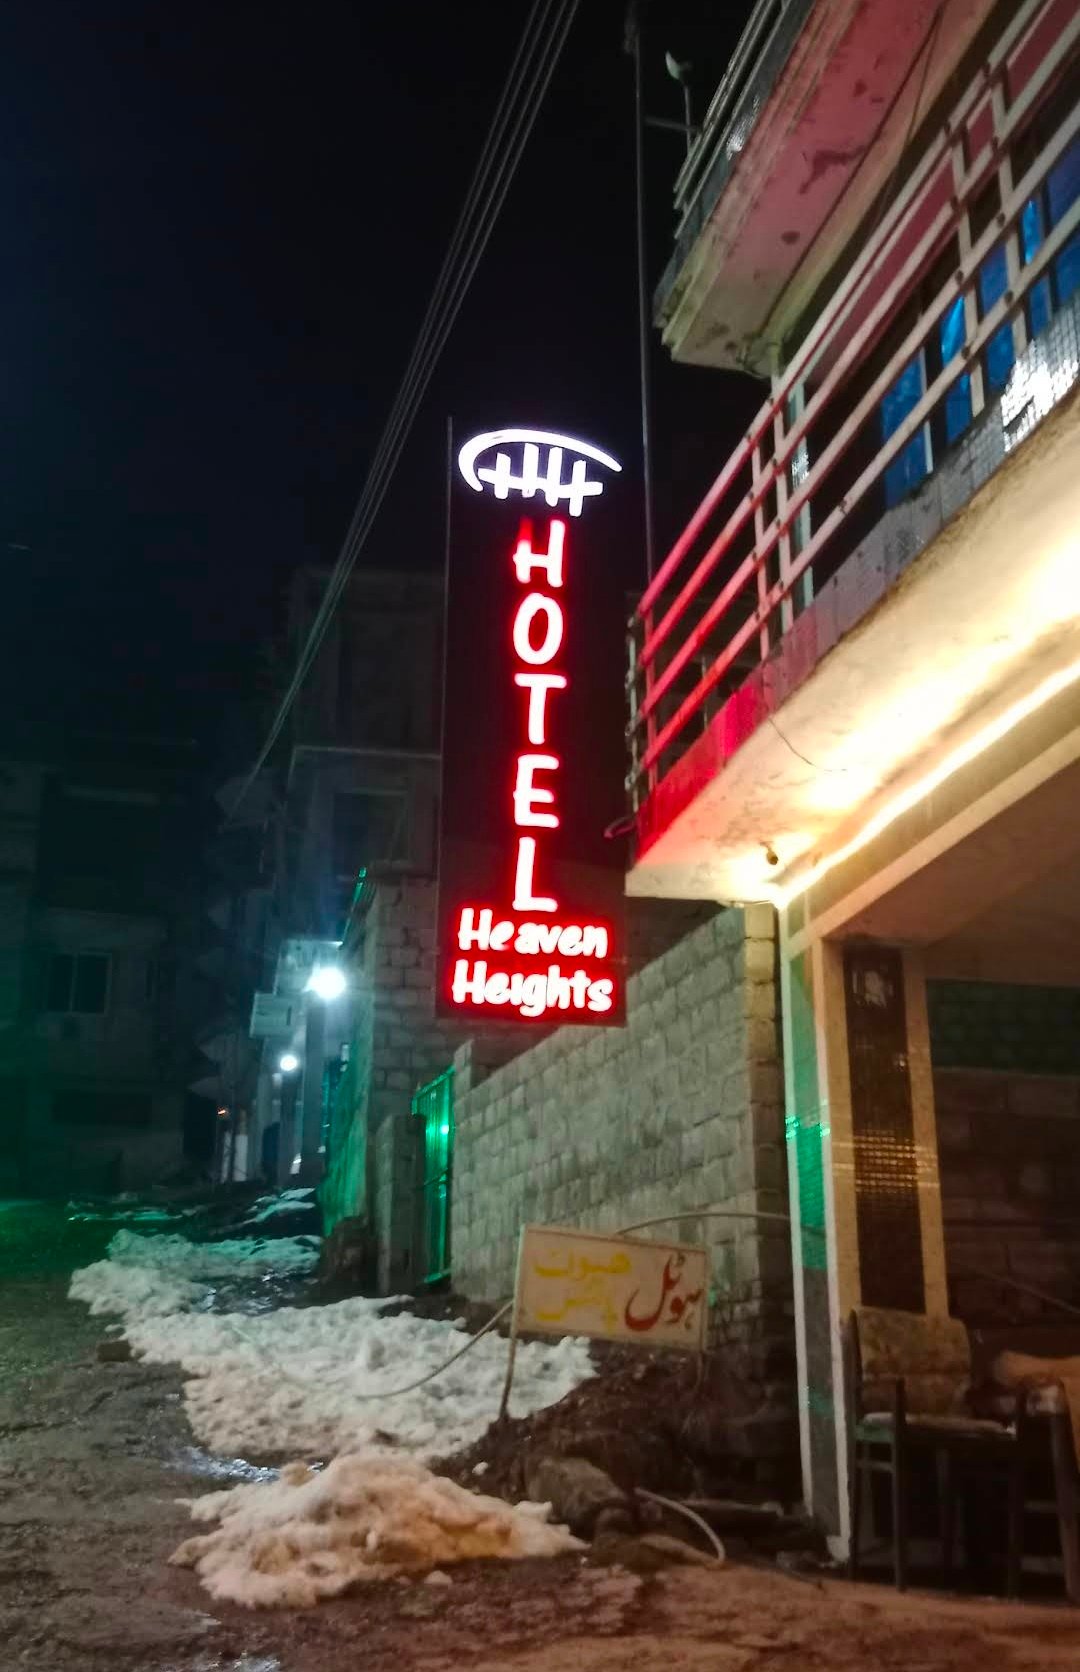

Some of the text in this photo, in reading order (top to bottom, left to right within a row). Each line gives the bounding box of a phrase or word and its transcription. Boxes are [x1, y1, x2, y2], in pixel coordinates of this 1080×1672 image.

[512, 517, 567, 913] HOTEL
[457, 907, 608, 959] Heaven
[451, 958, 613, 1018] Heights
